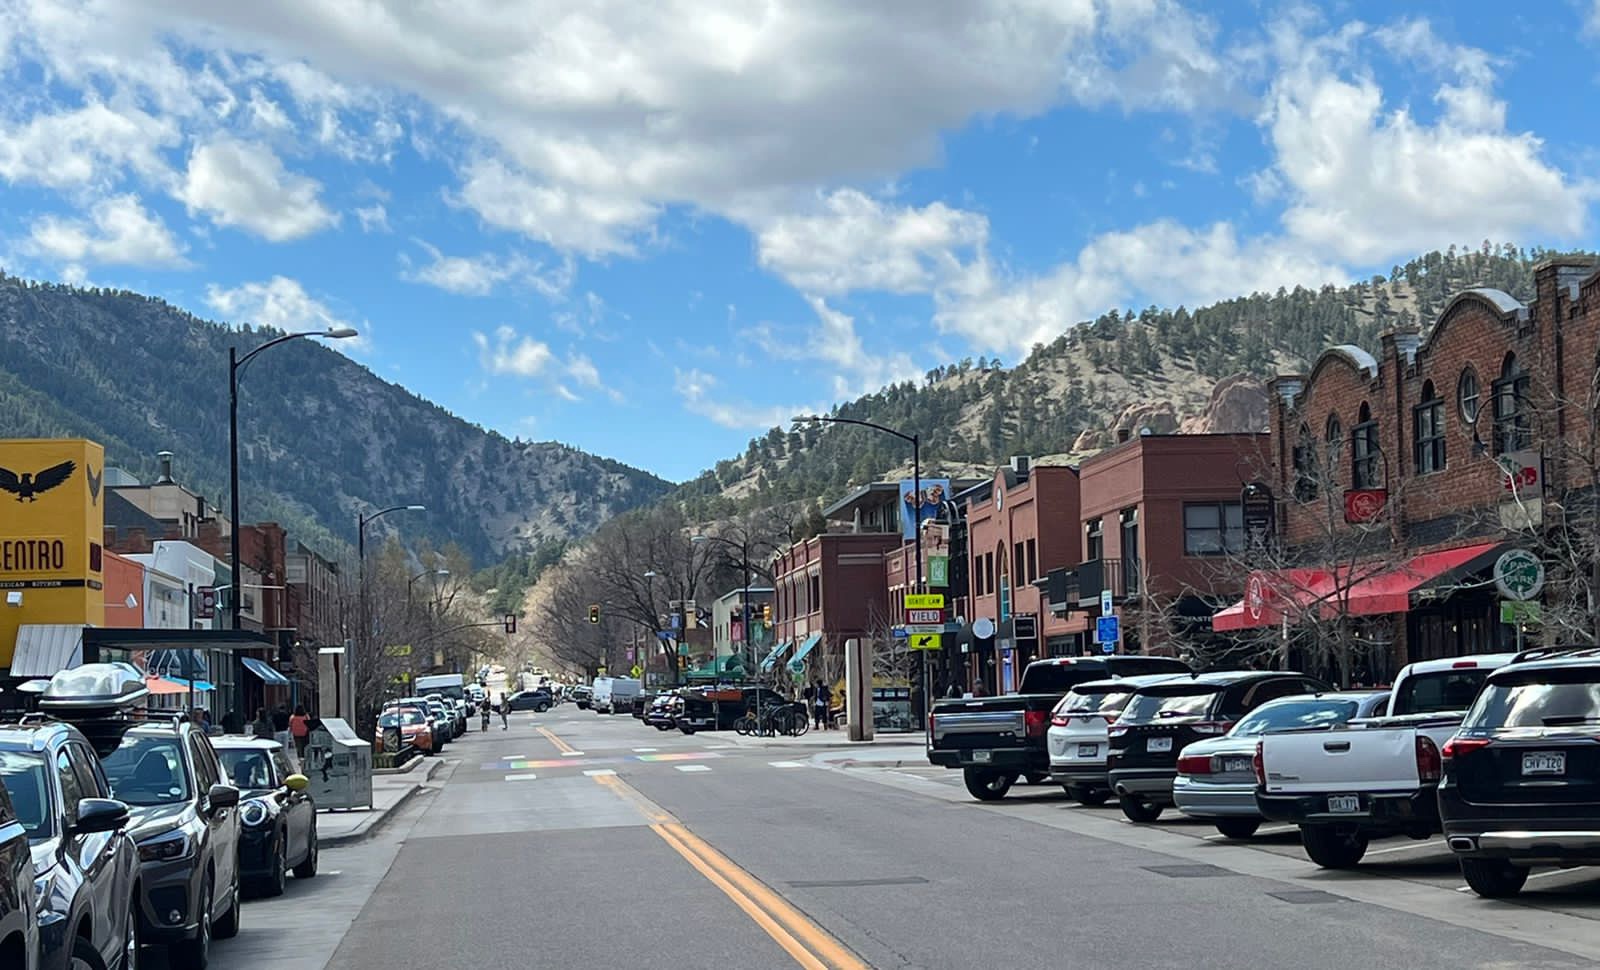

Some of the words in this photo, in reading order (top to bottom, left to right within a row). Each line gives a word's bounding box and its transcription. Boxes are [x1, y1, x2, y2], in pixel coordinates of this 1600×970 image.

[0, 540, 64, 570] ENTRO
[928, 597, 941, 605] LAW
[911, 611, 939, 621] YIELD
